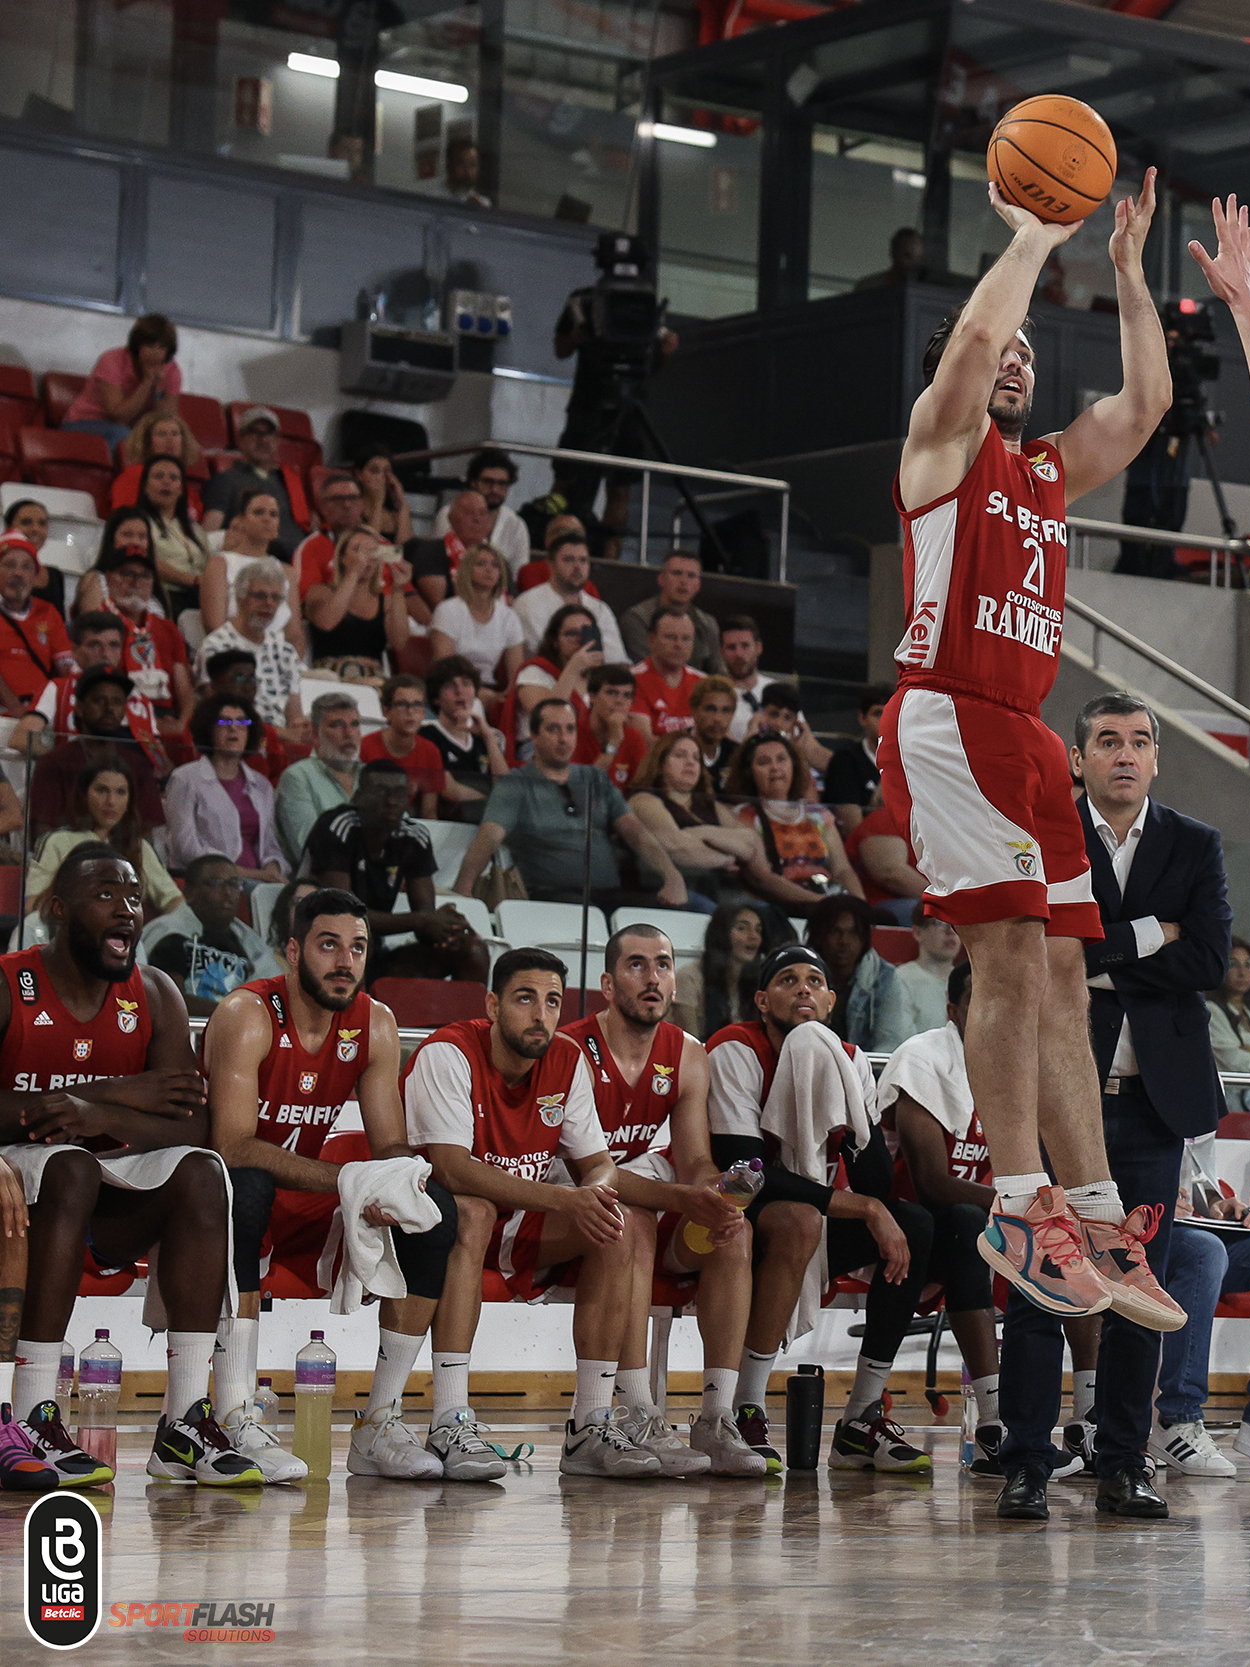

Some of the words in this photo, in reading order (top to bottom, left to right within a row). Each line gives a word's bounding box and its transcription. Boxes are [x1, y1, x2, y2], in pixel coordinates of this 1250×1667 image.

[1021, 182, 1071, 214] EVO
[985, 490, 1014, 524] SL
[1022, 537, 1045, 599] 21
[13, 1072, 42, 1092] SL
[258, 1097, 271, 1120] L
